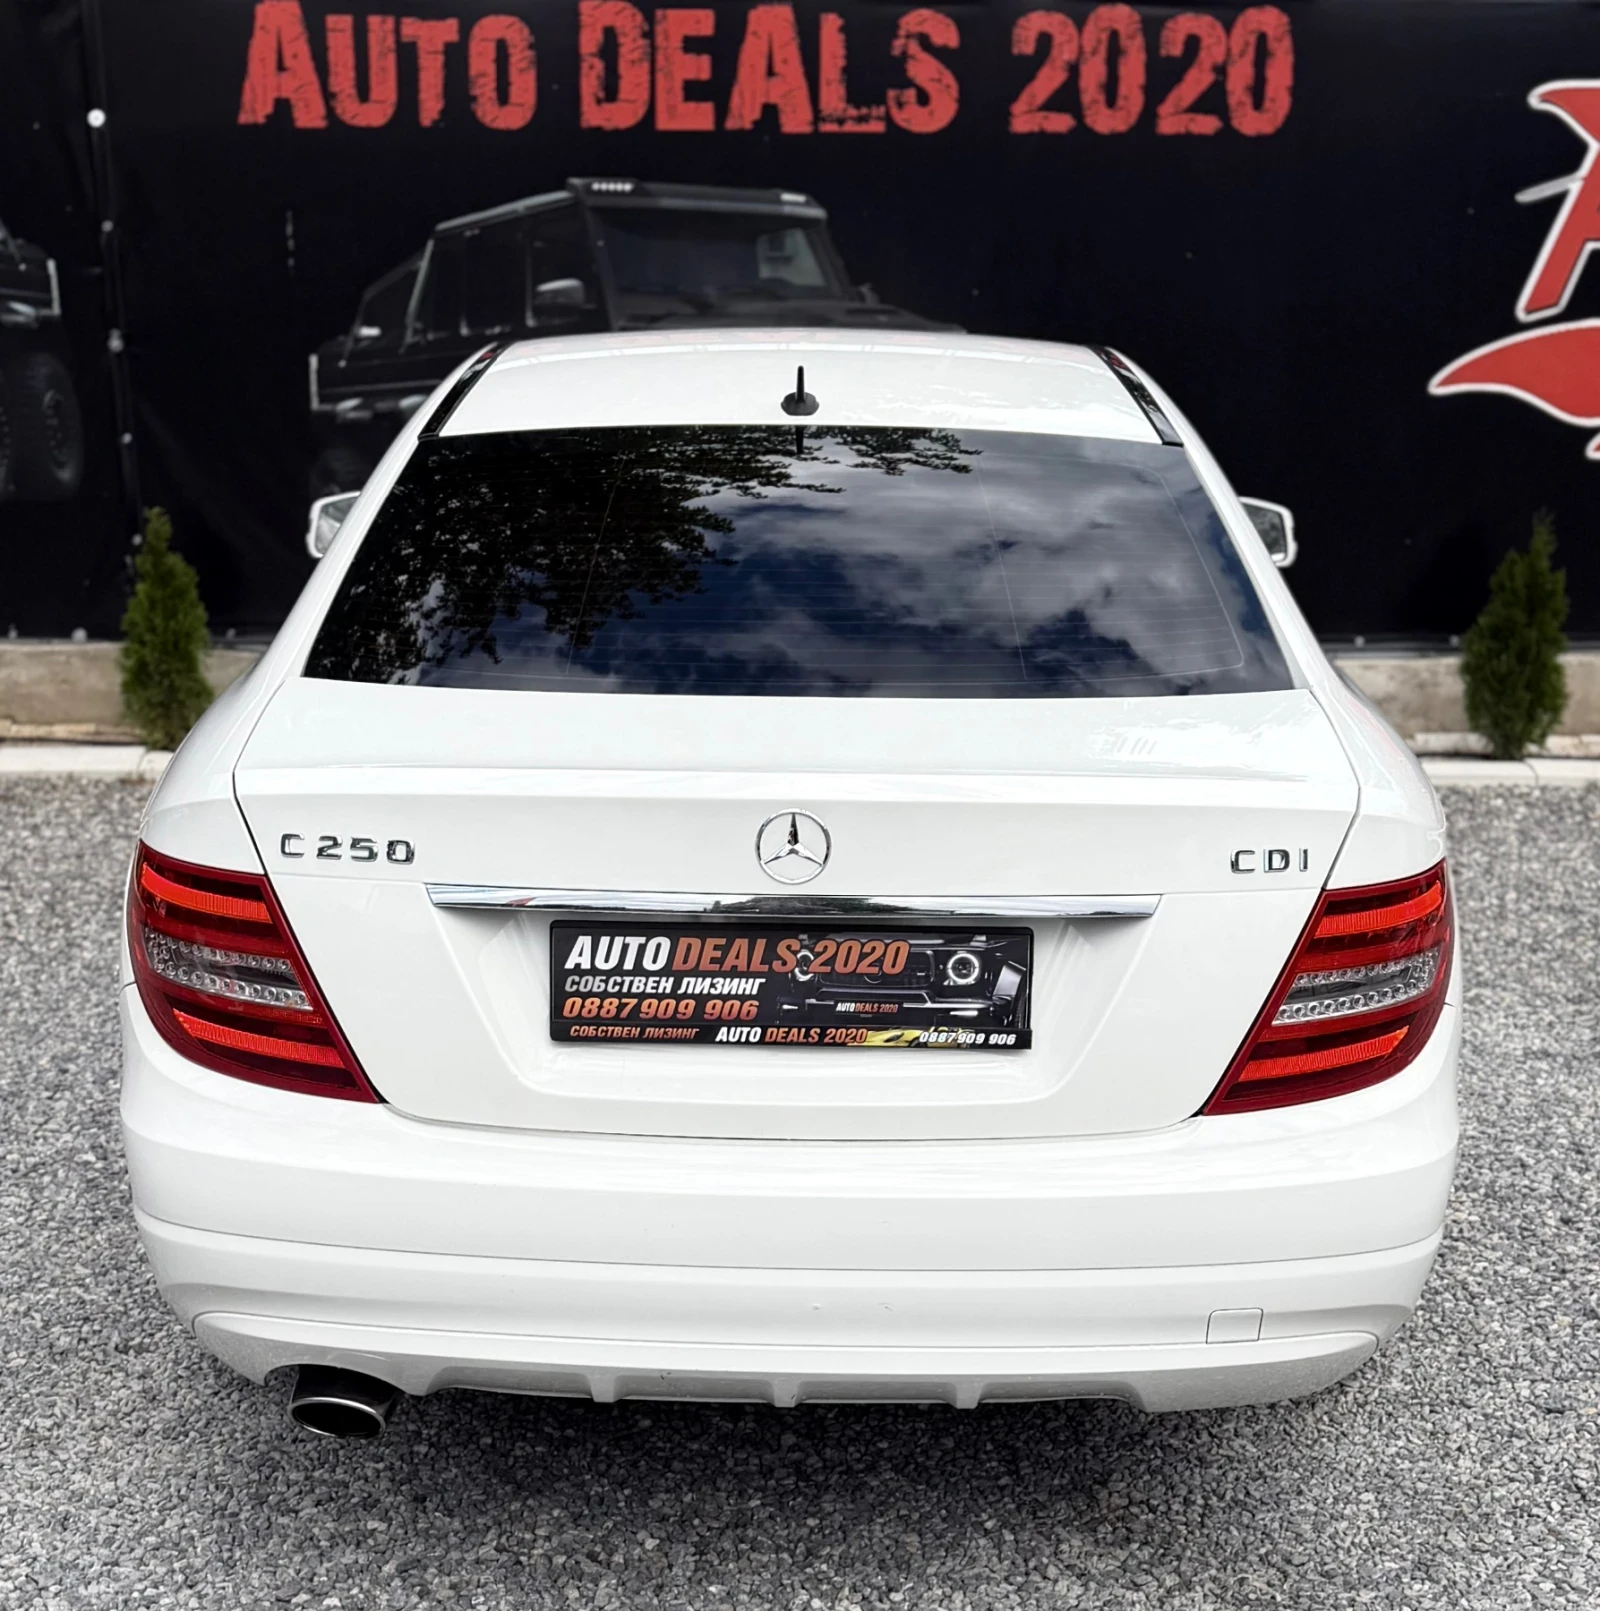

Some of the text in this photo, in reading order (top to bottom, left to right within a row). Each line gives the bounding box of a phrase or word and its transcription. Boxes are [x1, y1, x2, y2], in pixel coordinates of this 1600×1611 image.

[237, 0, 1294, 136] AUTO DEALS 2020
[280, 833, 416, 865] C 250
[1230, 848, 1309, 874] CDI
[564, 935, 910, 974] AUTO DEALS 2020
[564, 975, 766, 995] СОБСТВЕН ЛИЗИНГ
[562, 997, 759, 1021] 0887 909 906
[879, 1004, 899, 1013] 2020
[569, 1025, 699, 1040] СОБСТВЕН ЛИЗИНГ
[715, 1027, 868, 1044] AUTO DEALS 2020
[988, 1034, 1017, 1045] 906
